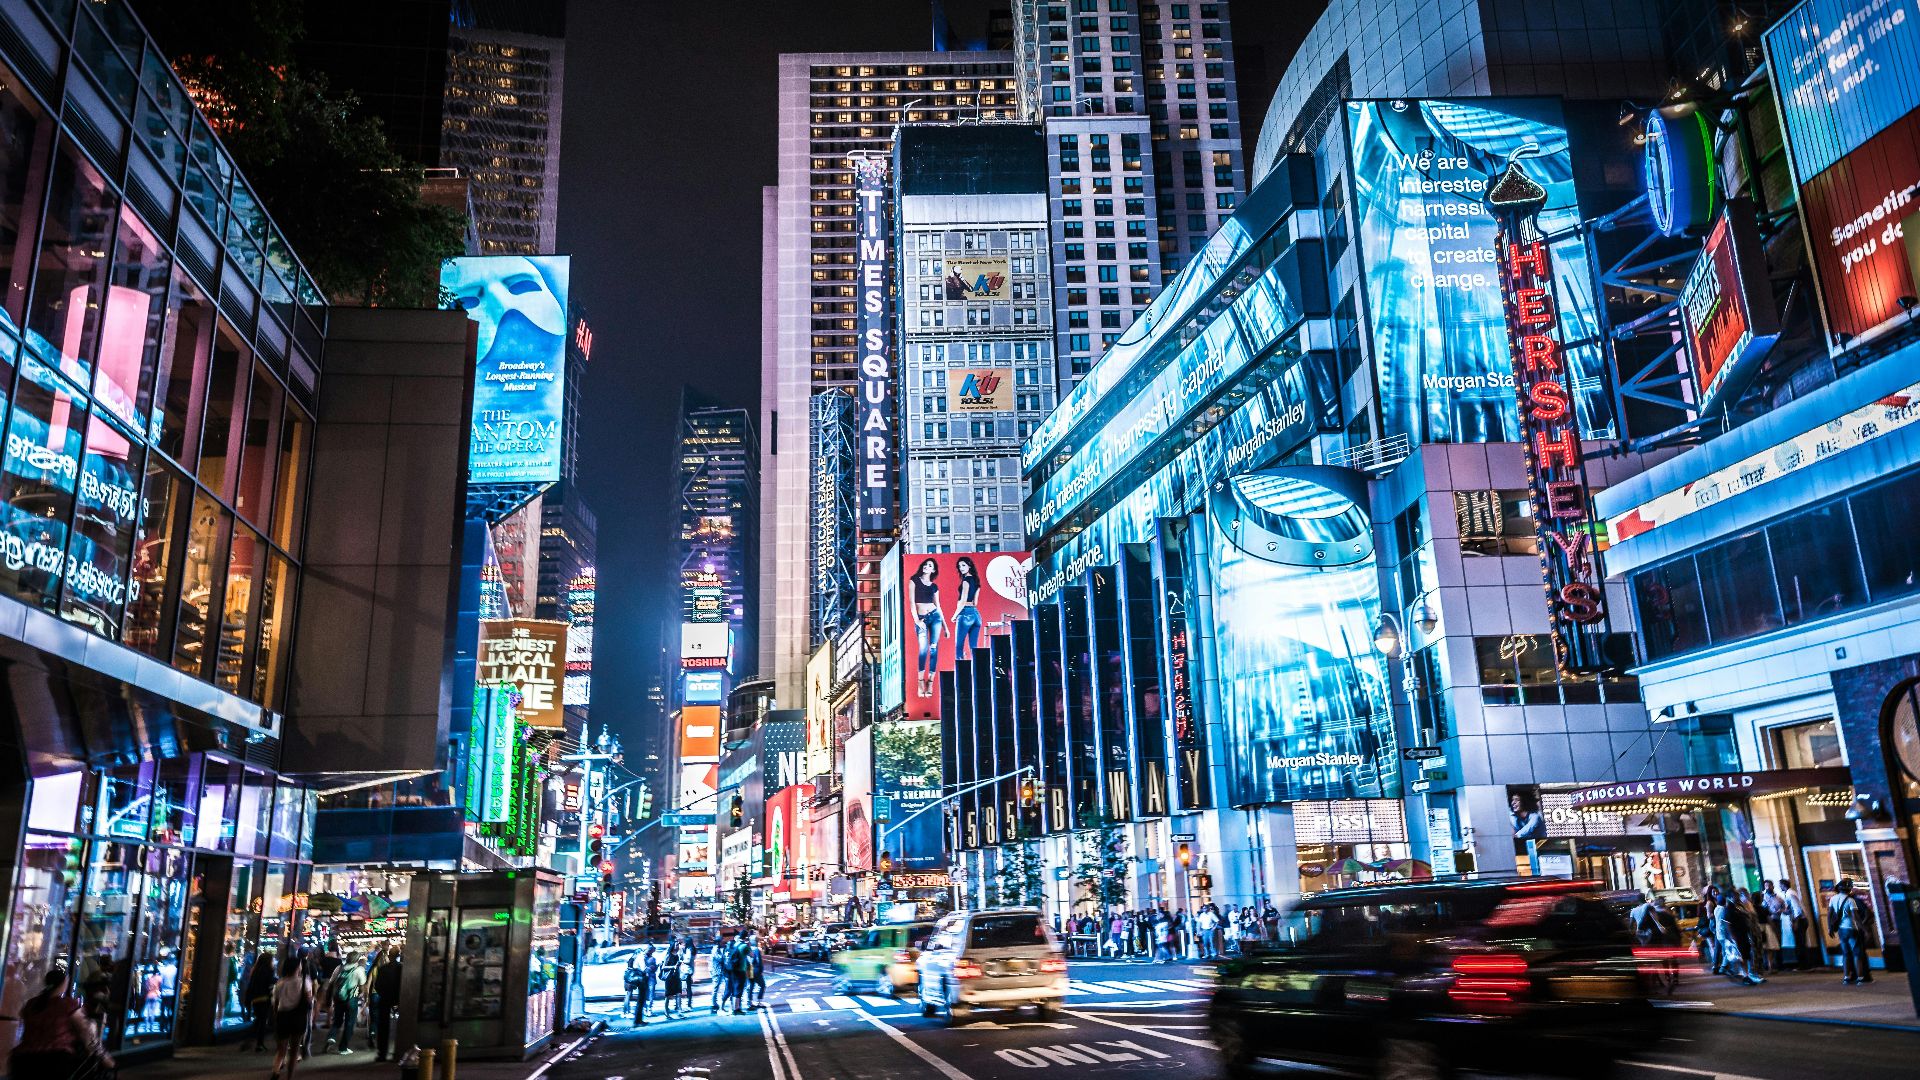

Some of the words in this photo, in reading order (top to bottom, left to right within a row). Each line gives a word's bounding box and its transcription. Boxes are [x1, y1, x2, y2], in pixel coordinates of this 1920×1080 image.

[1791, 0, 1891, 75] Sometime
[1793, 70, 1824, 106] you
[1828, 34, 1865, 75] feel
[1868, 8, 1905, 45] like
[1826, 86, 1839, 104] a
[1843, 58, 1880, 93] nut.
[1395, 154, 1431, 170] We
[1437, 157, 1469, 170] are
[1401, 199, 1489, 217] harnessi
[1404, 223, 1470, 244] capital
[860, 190, 885, 313] TIMES
[1407, 247, 1429, 264] to
[1433, 247, 1496, 264] create
[1842, 238, 1877, 275] you
[1410, 271, 1491, 292] change.
[486, 371, 554, 383] Longest-Running
[499, 361, 545, 372] Broadway's
[503, 382, 537, 392] Musical
[481, 409, 511, 421] THE
[862, 328, 888, 488] SQUARE
[471, 420, 557, 442] ANTOM
[1024, 511, 1039, 536] We
[1040, 499, 1055, 524] are
[1055, 450, 1100, 511] interested
[1101, 444, 1113, 468] in
[1112, 387, 1177, 459] harnessing
[1180, 341, 1225, 400] capital
[473, 442, 495, 454] HE
[496, 441, 545, 453] OPERA
[818, 455, 827, 498] EAGLE
[826, 473, 836, 569] OUTFITTERS
[867, 507, 887, 515] NYC
[818, 508, 828, 593] AMERICAN
[1028, 589, 1038, 610] to
[1038, 569, 1065, 602] create
[1066, 544, 1104, 584] change.
[682, 658, 727, 668] TOSHIBA
[700, 683, 719, 691] TDK
[1266, 755, 1316, 770] Morgan
[1316, 752, 1364, 768] Stanley
[903, 789, 942, 800] SHERMAN
[1586, 781, 1668, 801] CHOCOLATE
[1679, 775, 1753, 792] WORLD
[993, 1039, 1173, 1069] ONLY
